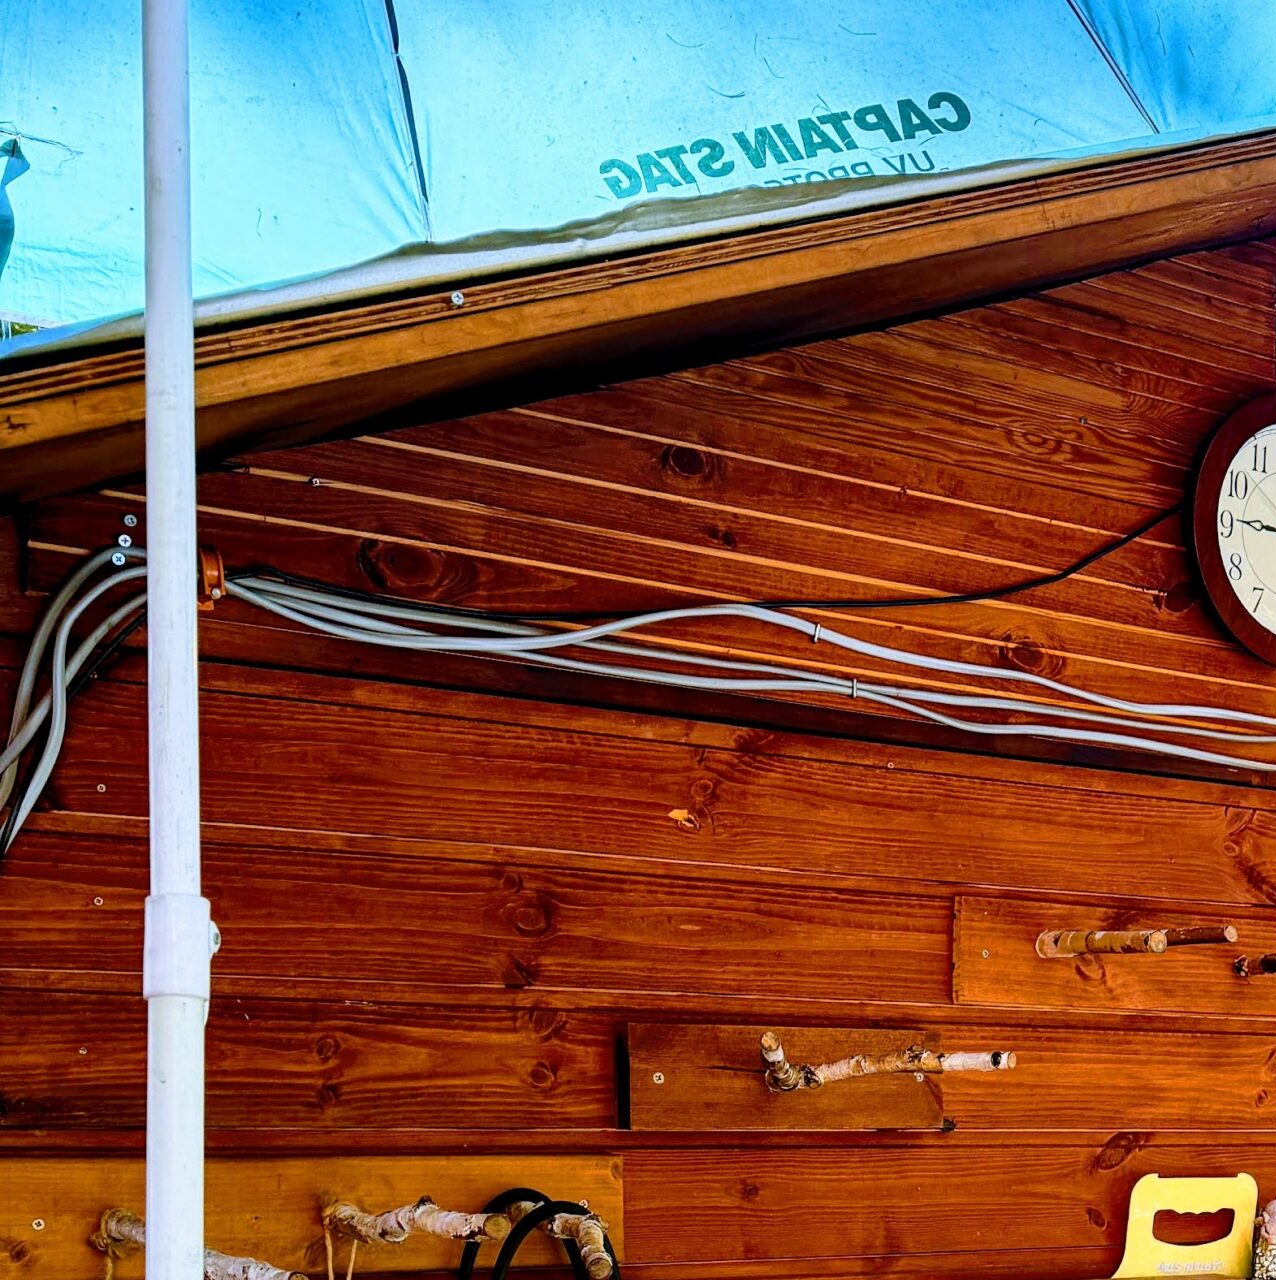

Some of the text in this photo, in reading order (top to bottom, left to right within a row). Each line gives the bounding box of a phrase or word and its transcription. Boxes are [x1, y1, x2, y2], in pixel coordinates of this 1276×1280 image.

[1252, 443, 1267, 474] 11
[1228, 469, 1248, 500] 10
[1220, 509, 1234, 538] 9
[1228, 552, 1243, 581] 8
[1251, 586, 1265, 614] 7
